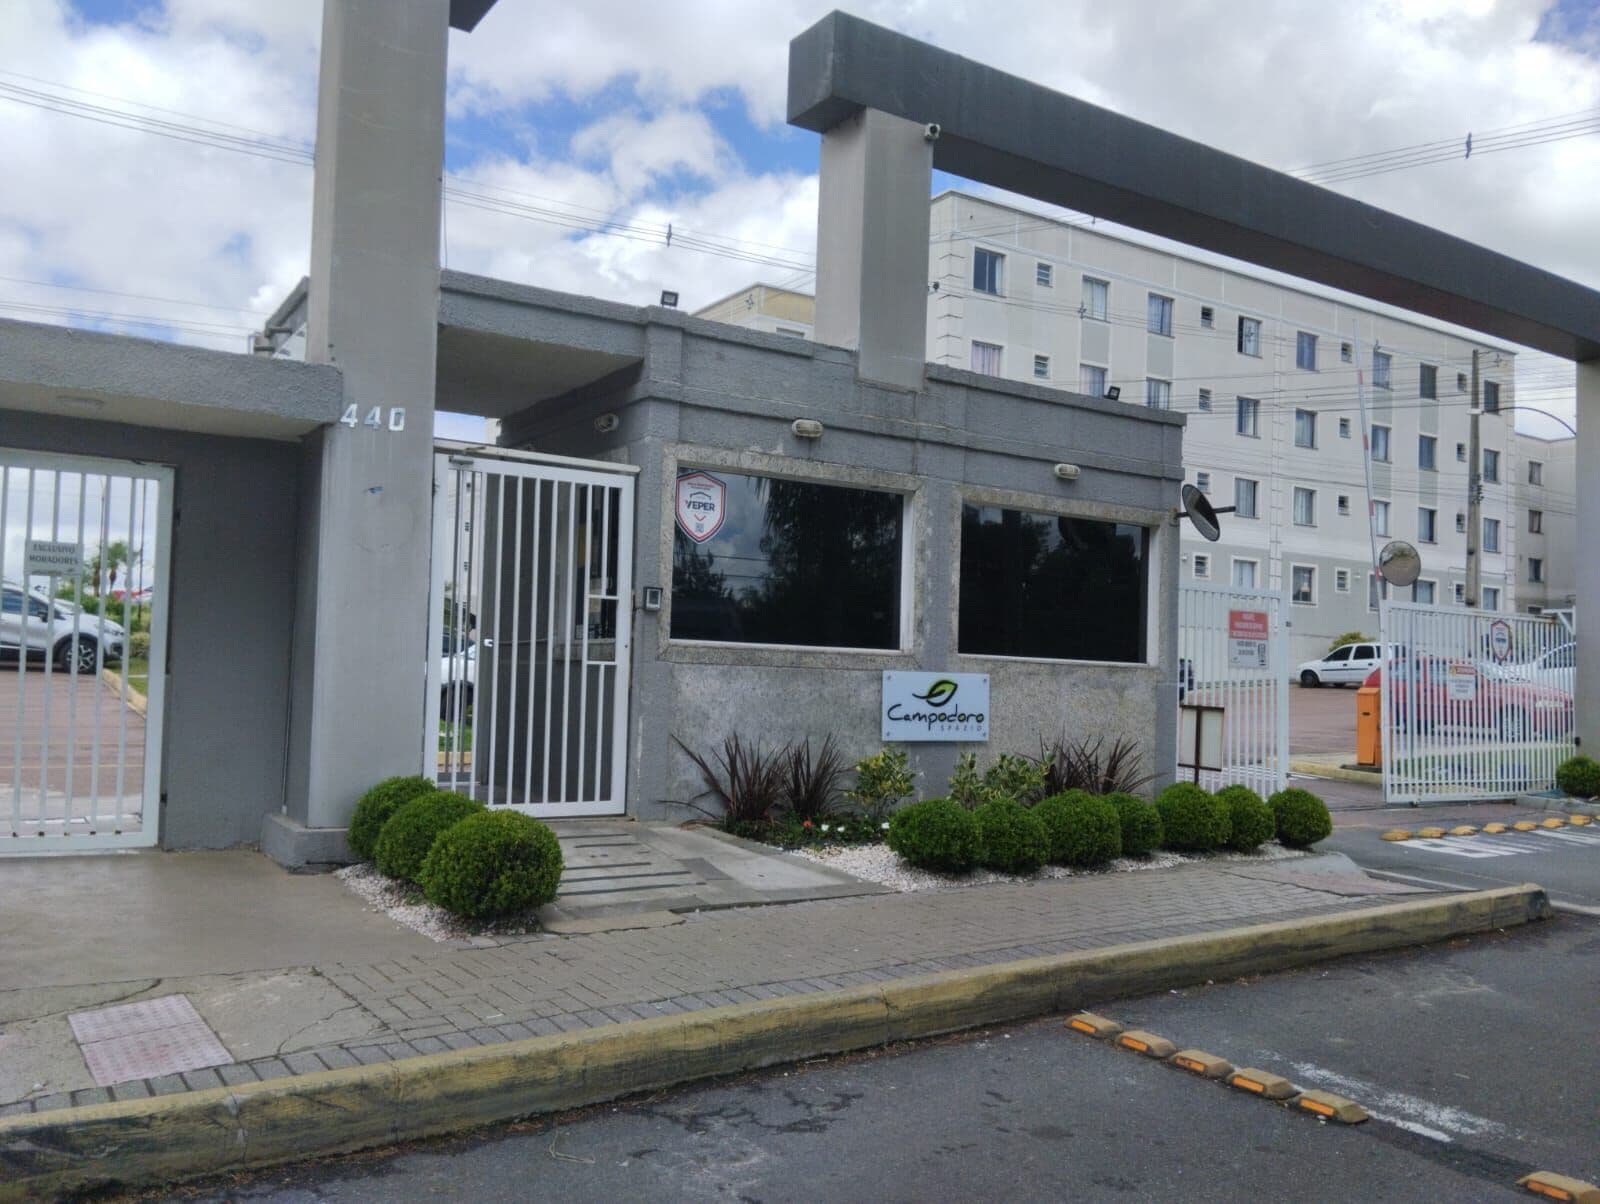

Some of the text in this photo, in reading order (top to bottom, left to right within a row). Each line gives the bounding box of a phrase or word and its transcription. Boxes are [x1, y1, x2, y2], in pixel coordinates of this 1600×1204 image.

[339, 403, 406, 431] 440
[685, 500, 716, 512] VEPER
[887, 703, 985, 732] Campodoro
